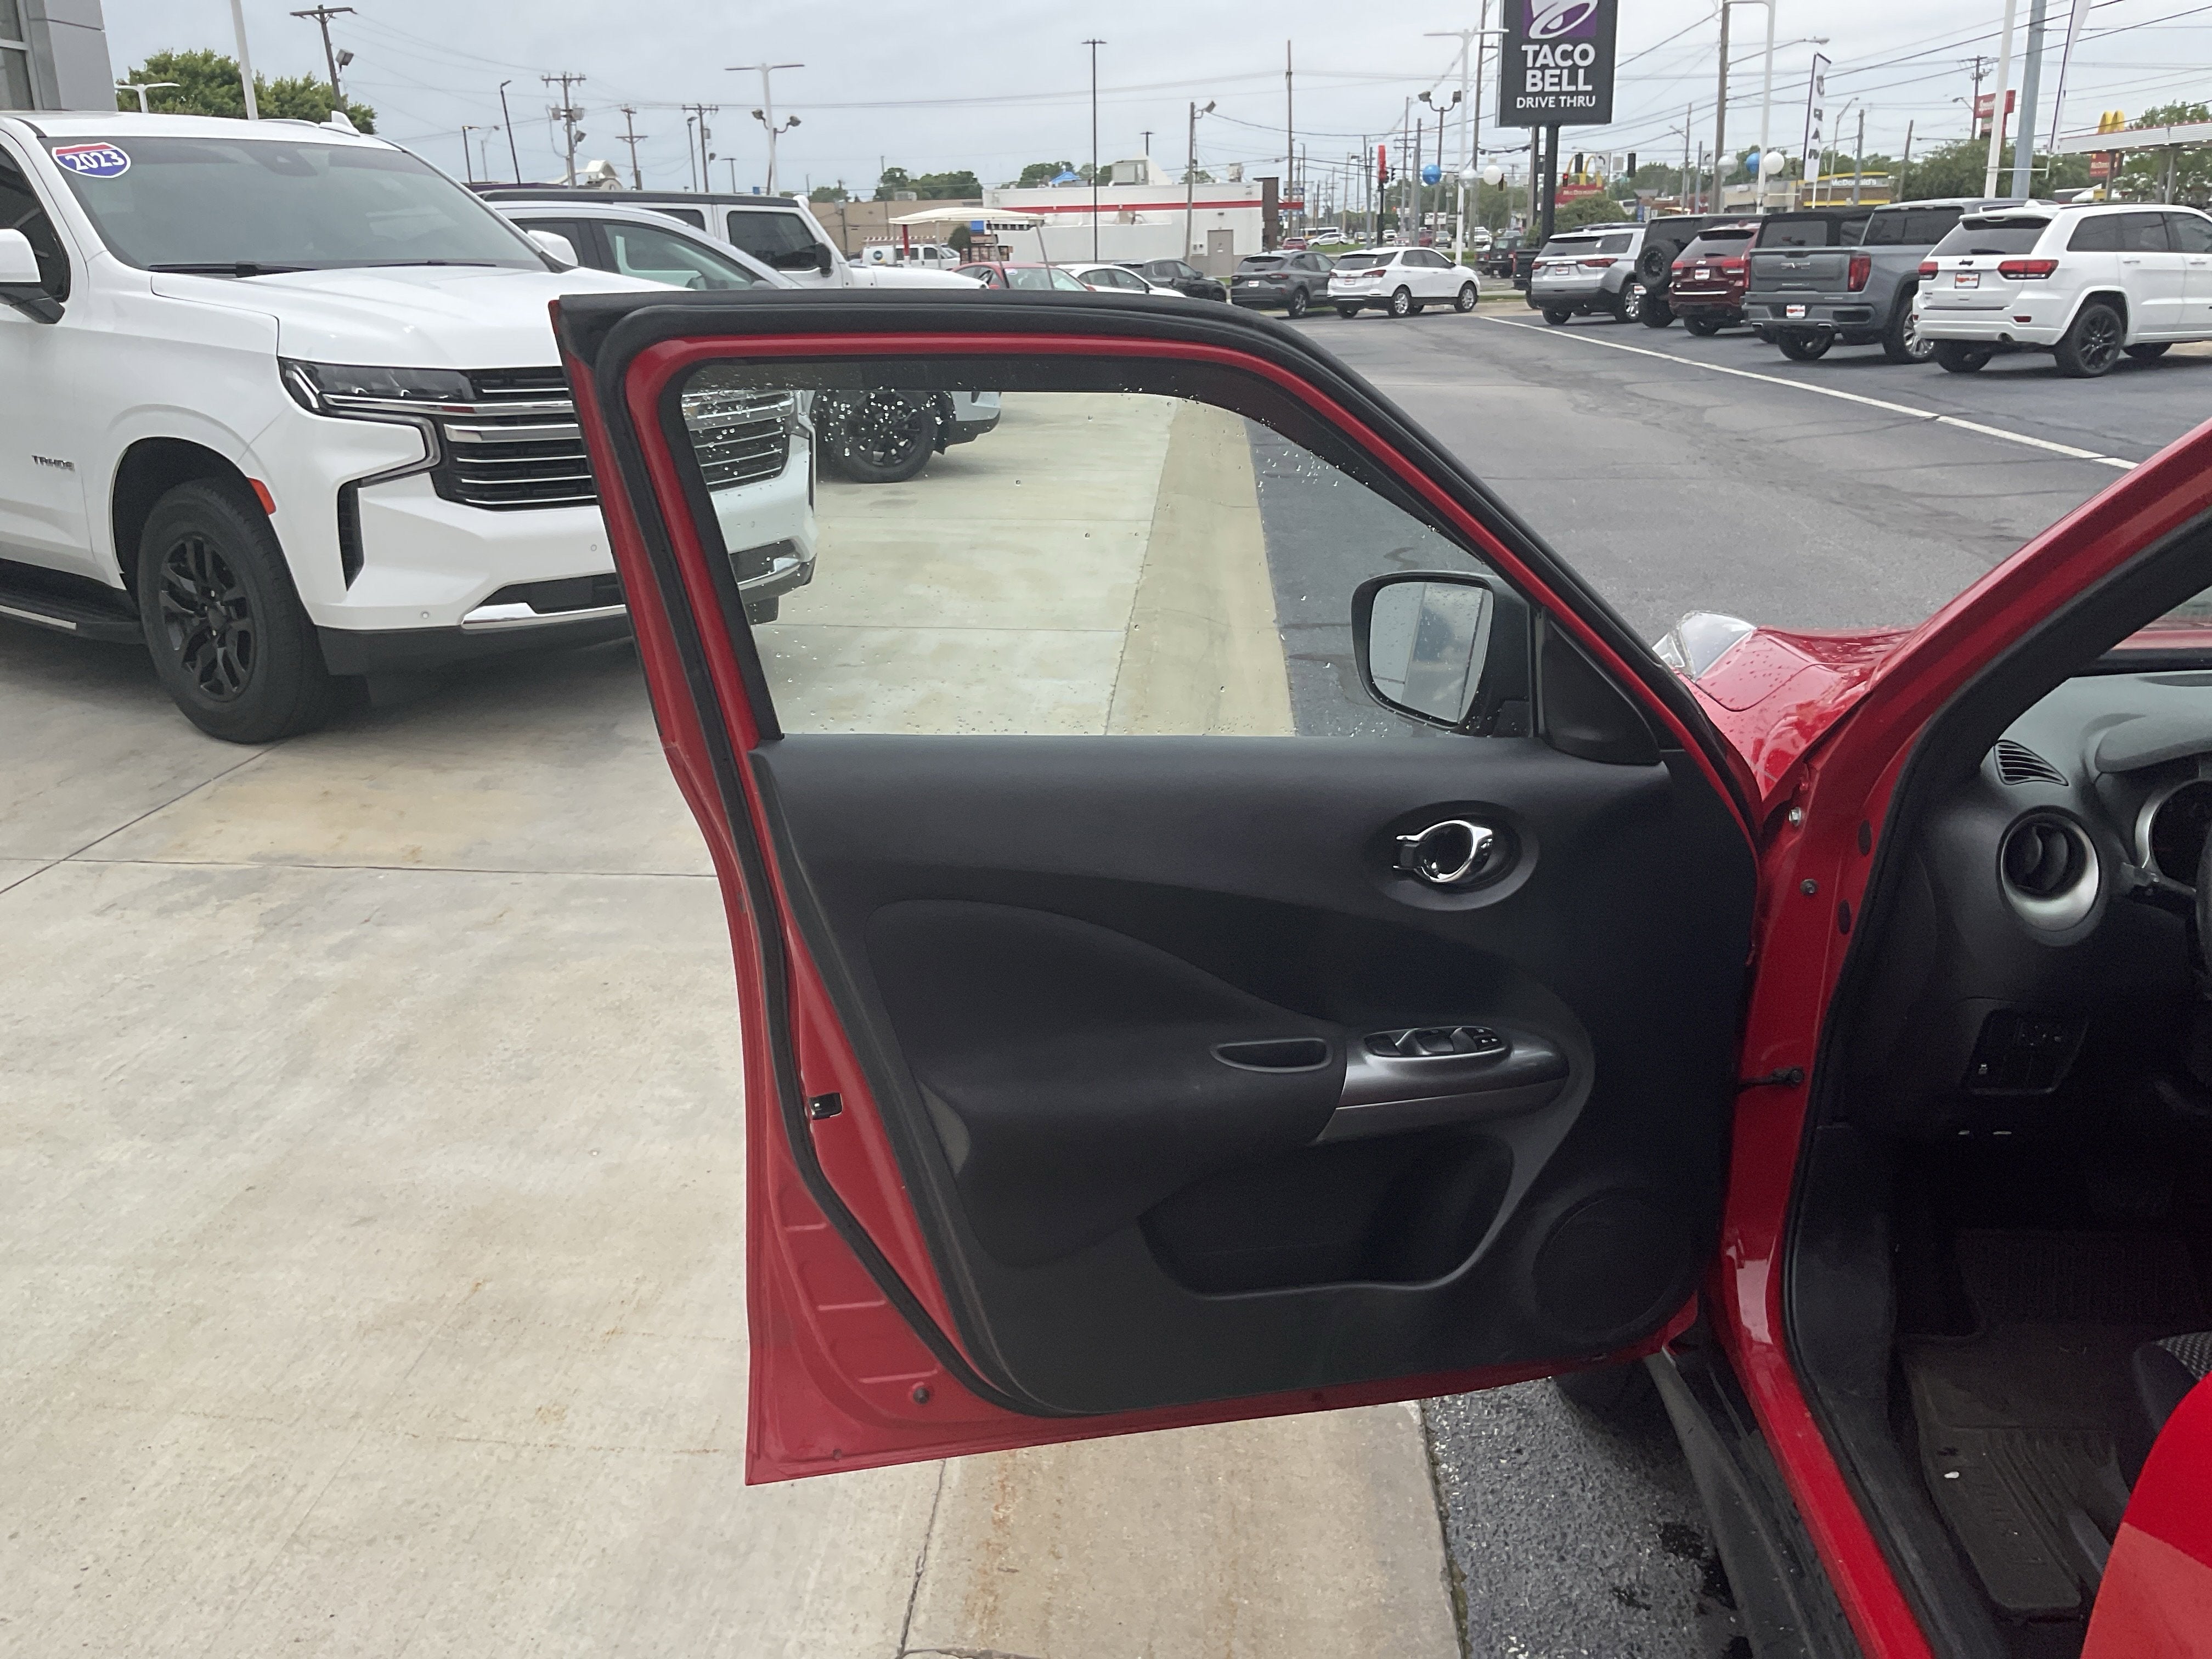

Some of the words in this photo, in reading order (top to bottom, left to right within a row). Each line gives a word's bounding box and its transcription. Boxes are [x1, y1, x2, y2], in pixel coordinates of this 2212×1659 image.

[1521, 43, 1595, 67] TACO
[1525, 68, 1593, 92] BELL
[1516, 96, 1555, 109] DRIVE
[1559, 95, 1595, 108] THRU
[65, 150, 125, 171] 2023
